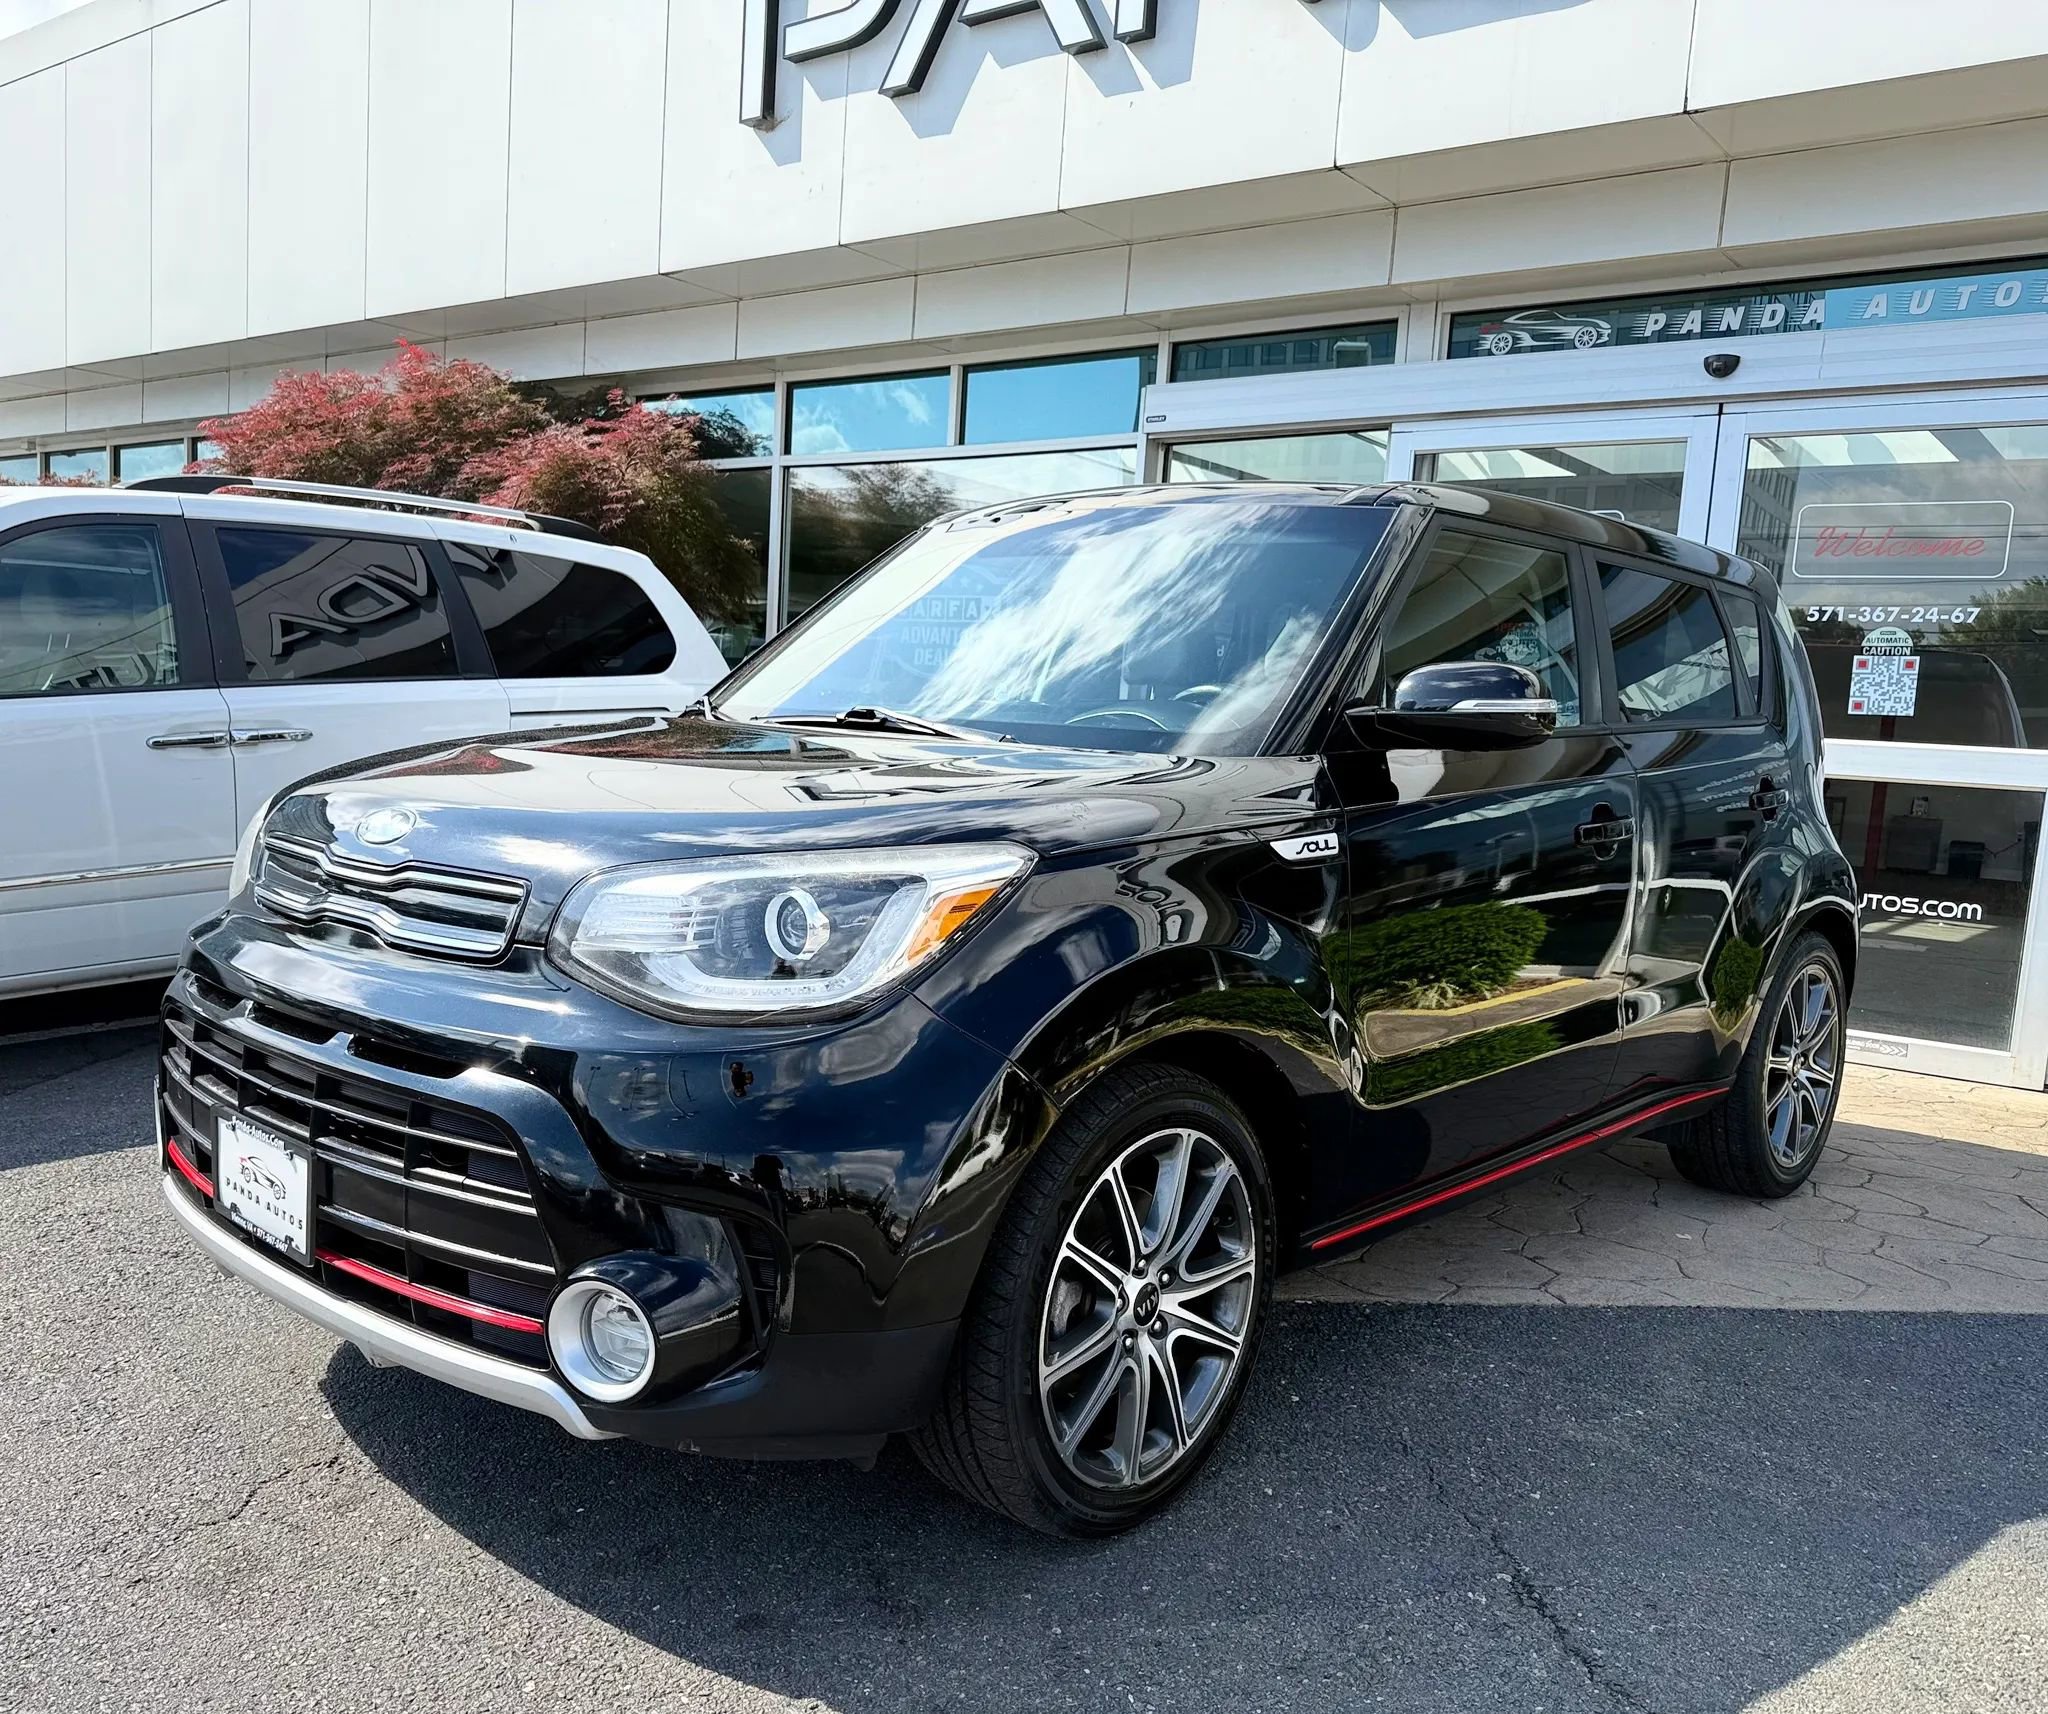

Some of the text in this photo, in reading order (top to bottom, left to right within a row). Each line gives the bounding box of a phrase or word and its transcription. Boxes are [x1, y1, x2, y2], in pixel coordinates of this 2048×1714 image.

[1631, 278, 2048, 337] PANDA AUTO
[1814, 525, 1985, 557] Welcome
[1806, 606, 1981, 625] 571-367-24-67
[1862, 646, 1911, 656] CAUTION
[1865, 636, 1910, 645] AUTOMATIC
[225, 1177, 303, 1230] PANDA AUTOS
